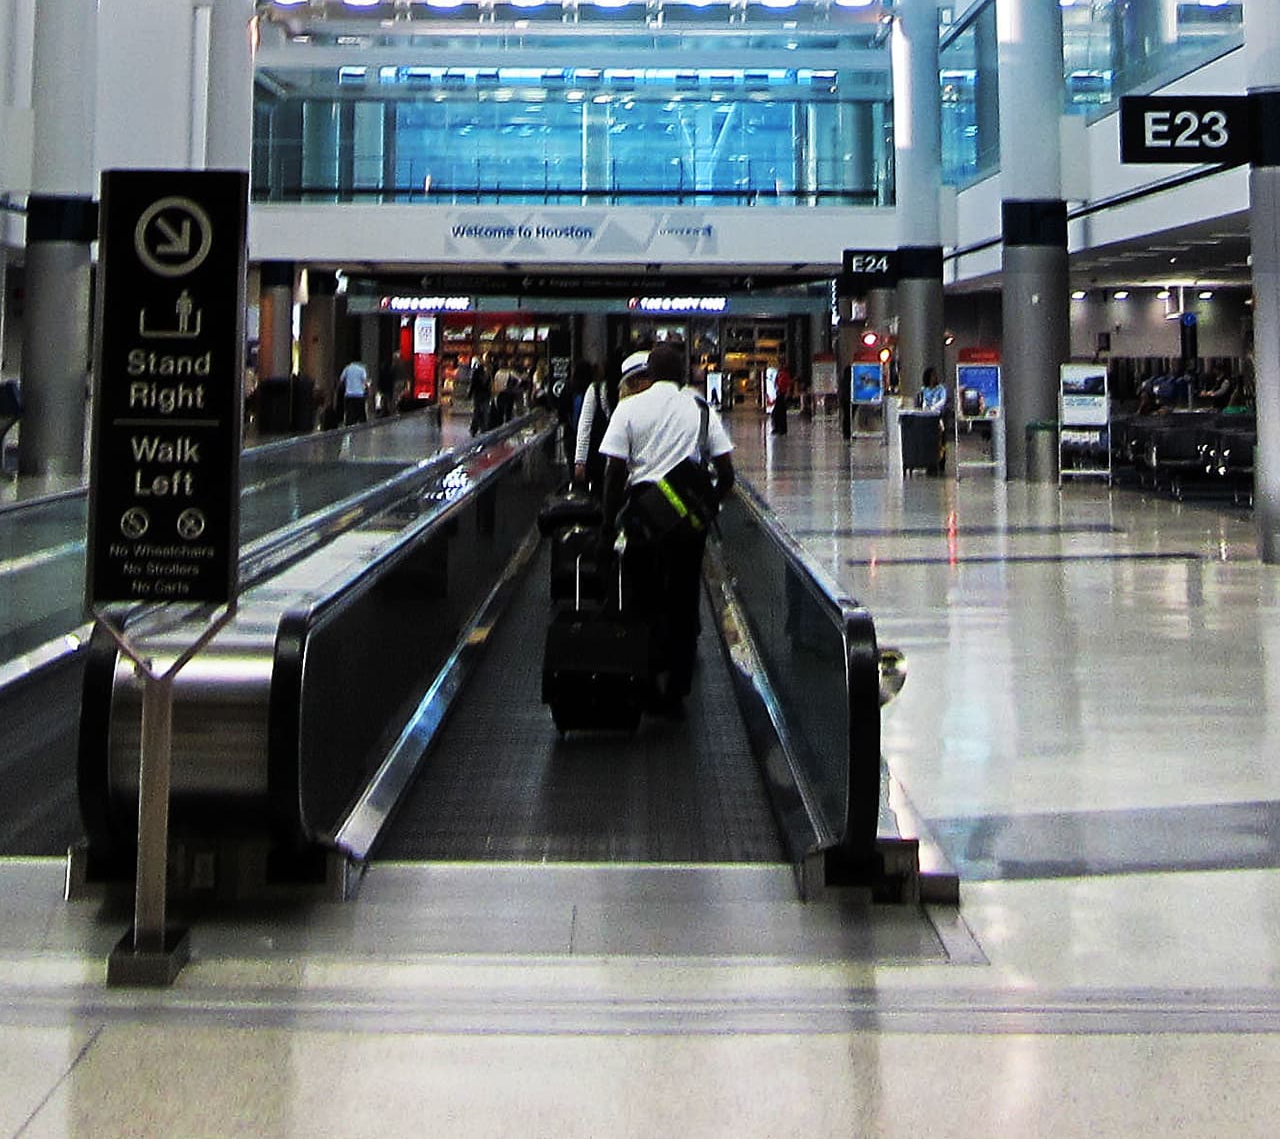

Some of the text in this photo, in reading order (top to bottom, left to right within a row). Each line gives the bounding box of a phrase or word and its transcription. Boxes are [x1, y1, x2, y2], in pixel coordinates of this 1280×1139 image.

[1144, 110, 1229, 148] E23
[451, 223, 593, 238] Welcome to Houston
[852, 255, 889, 273] E24
[127, 348, 211, 376] Stand
[129, 382, 205, 413] Right
[131, 436, 201, 463] Walk
[134, 469, 194, 496] Left
[109, 543, 215, 559] No Wheelchairs
[123, 561, 200, 575] No Strollers
[132, 580, 190, 594] No Carts
